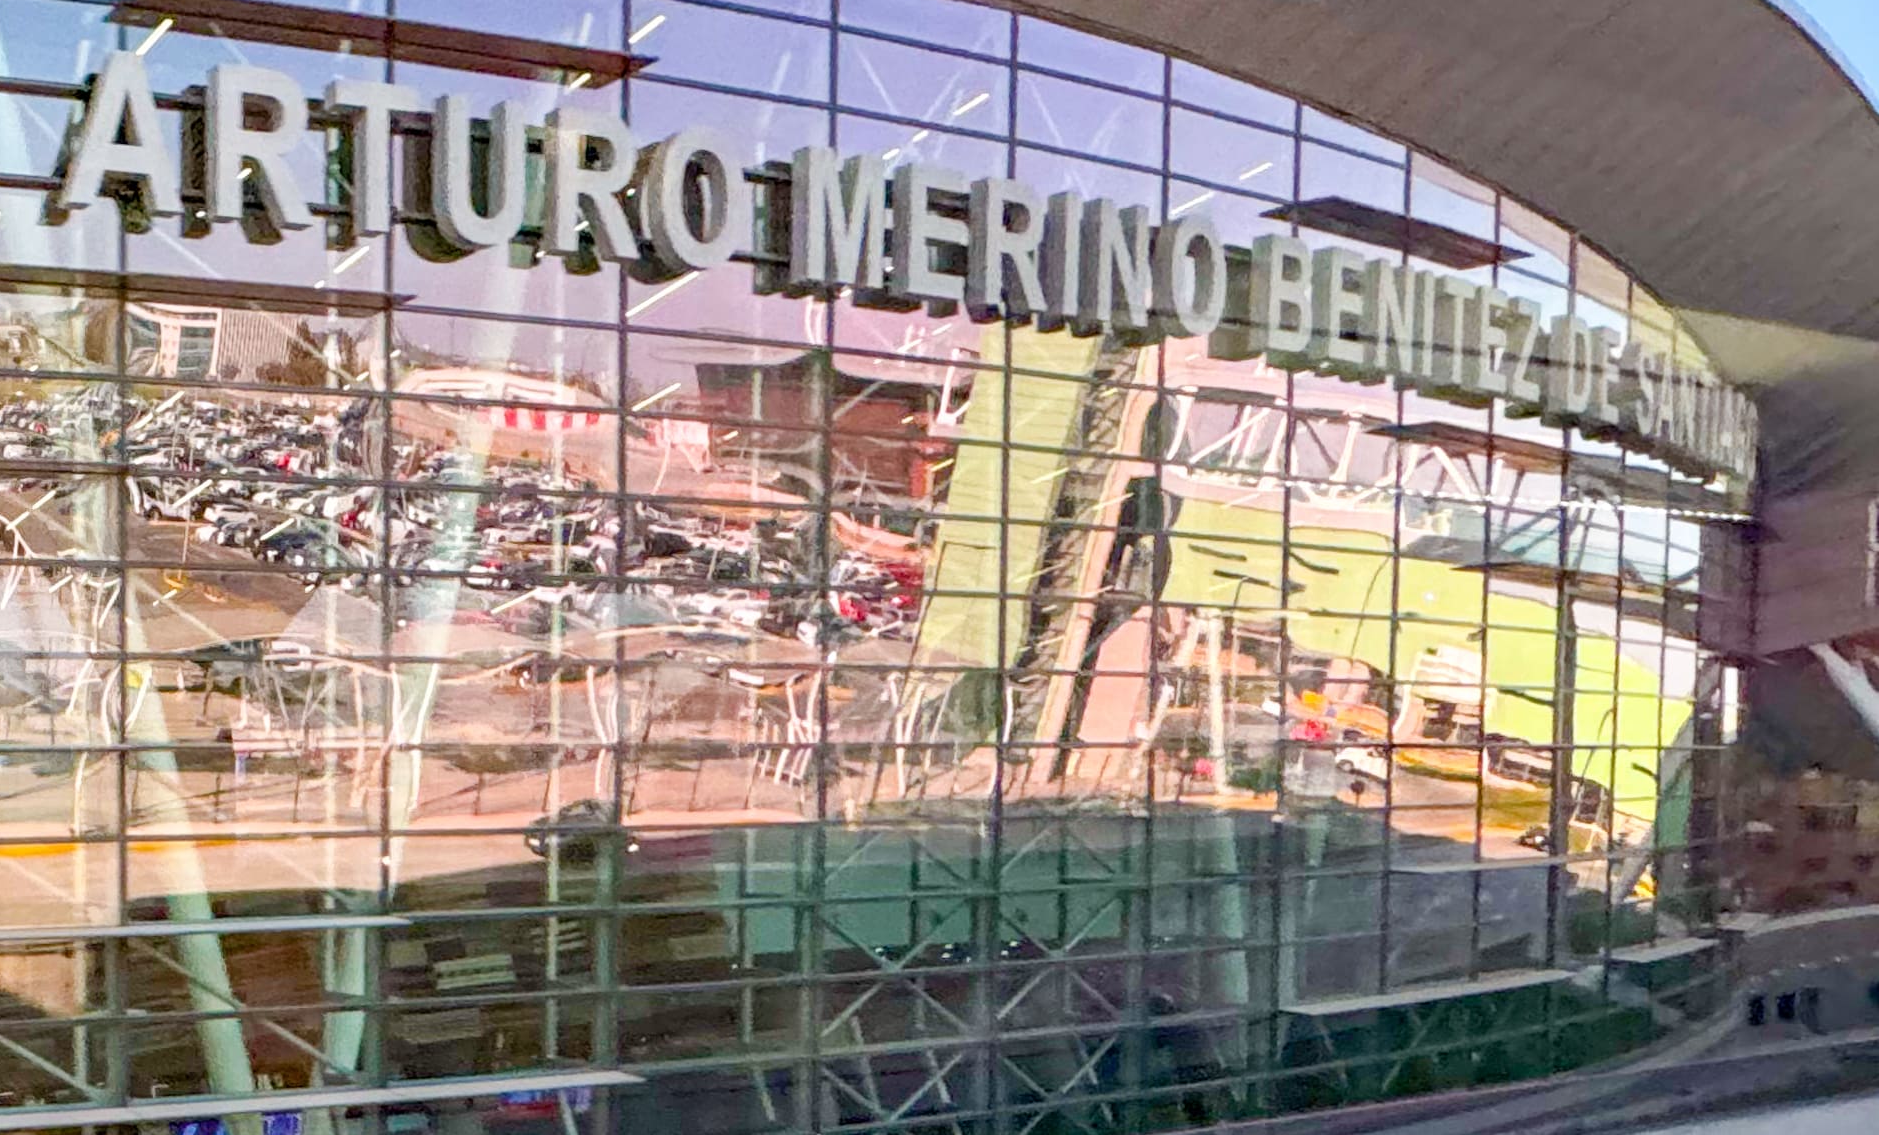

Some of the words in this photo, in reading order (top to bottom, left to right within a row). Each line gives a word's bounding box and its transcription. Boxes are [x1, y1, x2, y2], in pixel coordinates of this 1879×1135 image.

[59, 51, 730, 271] ARTURO
[792, 146, 1226, 336] MERINO
[1251, 233, 1544, 404] BENITEZ
[1551, 315, 1620, 424] DE
